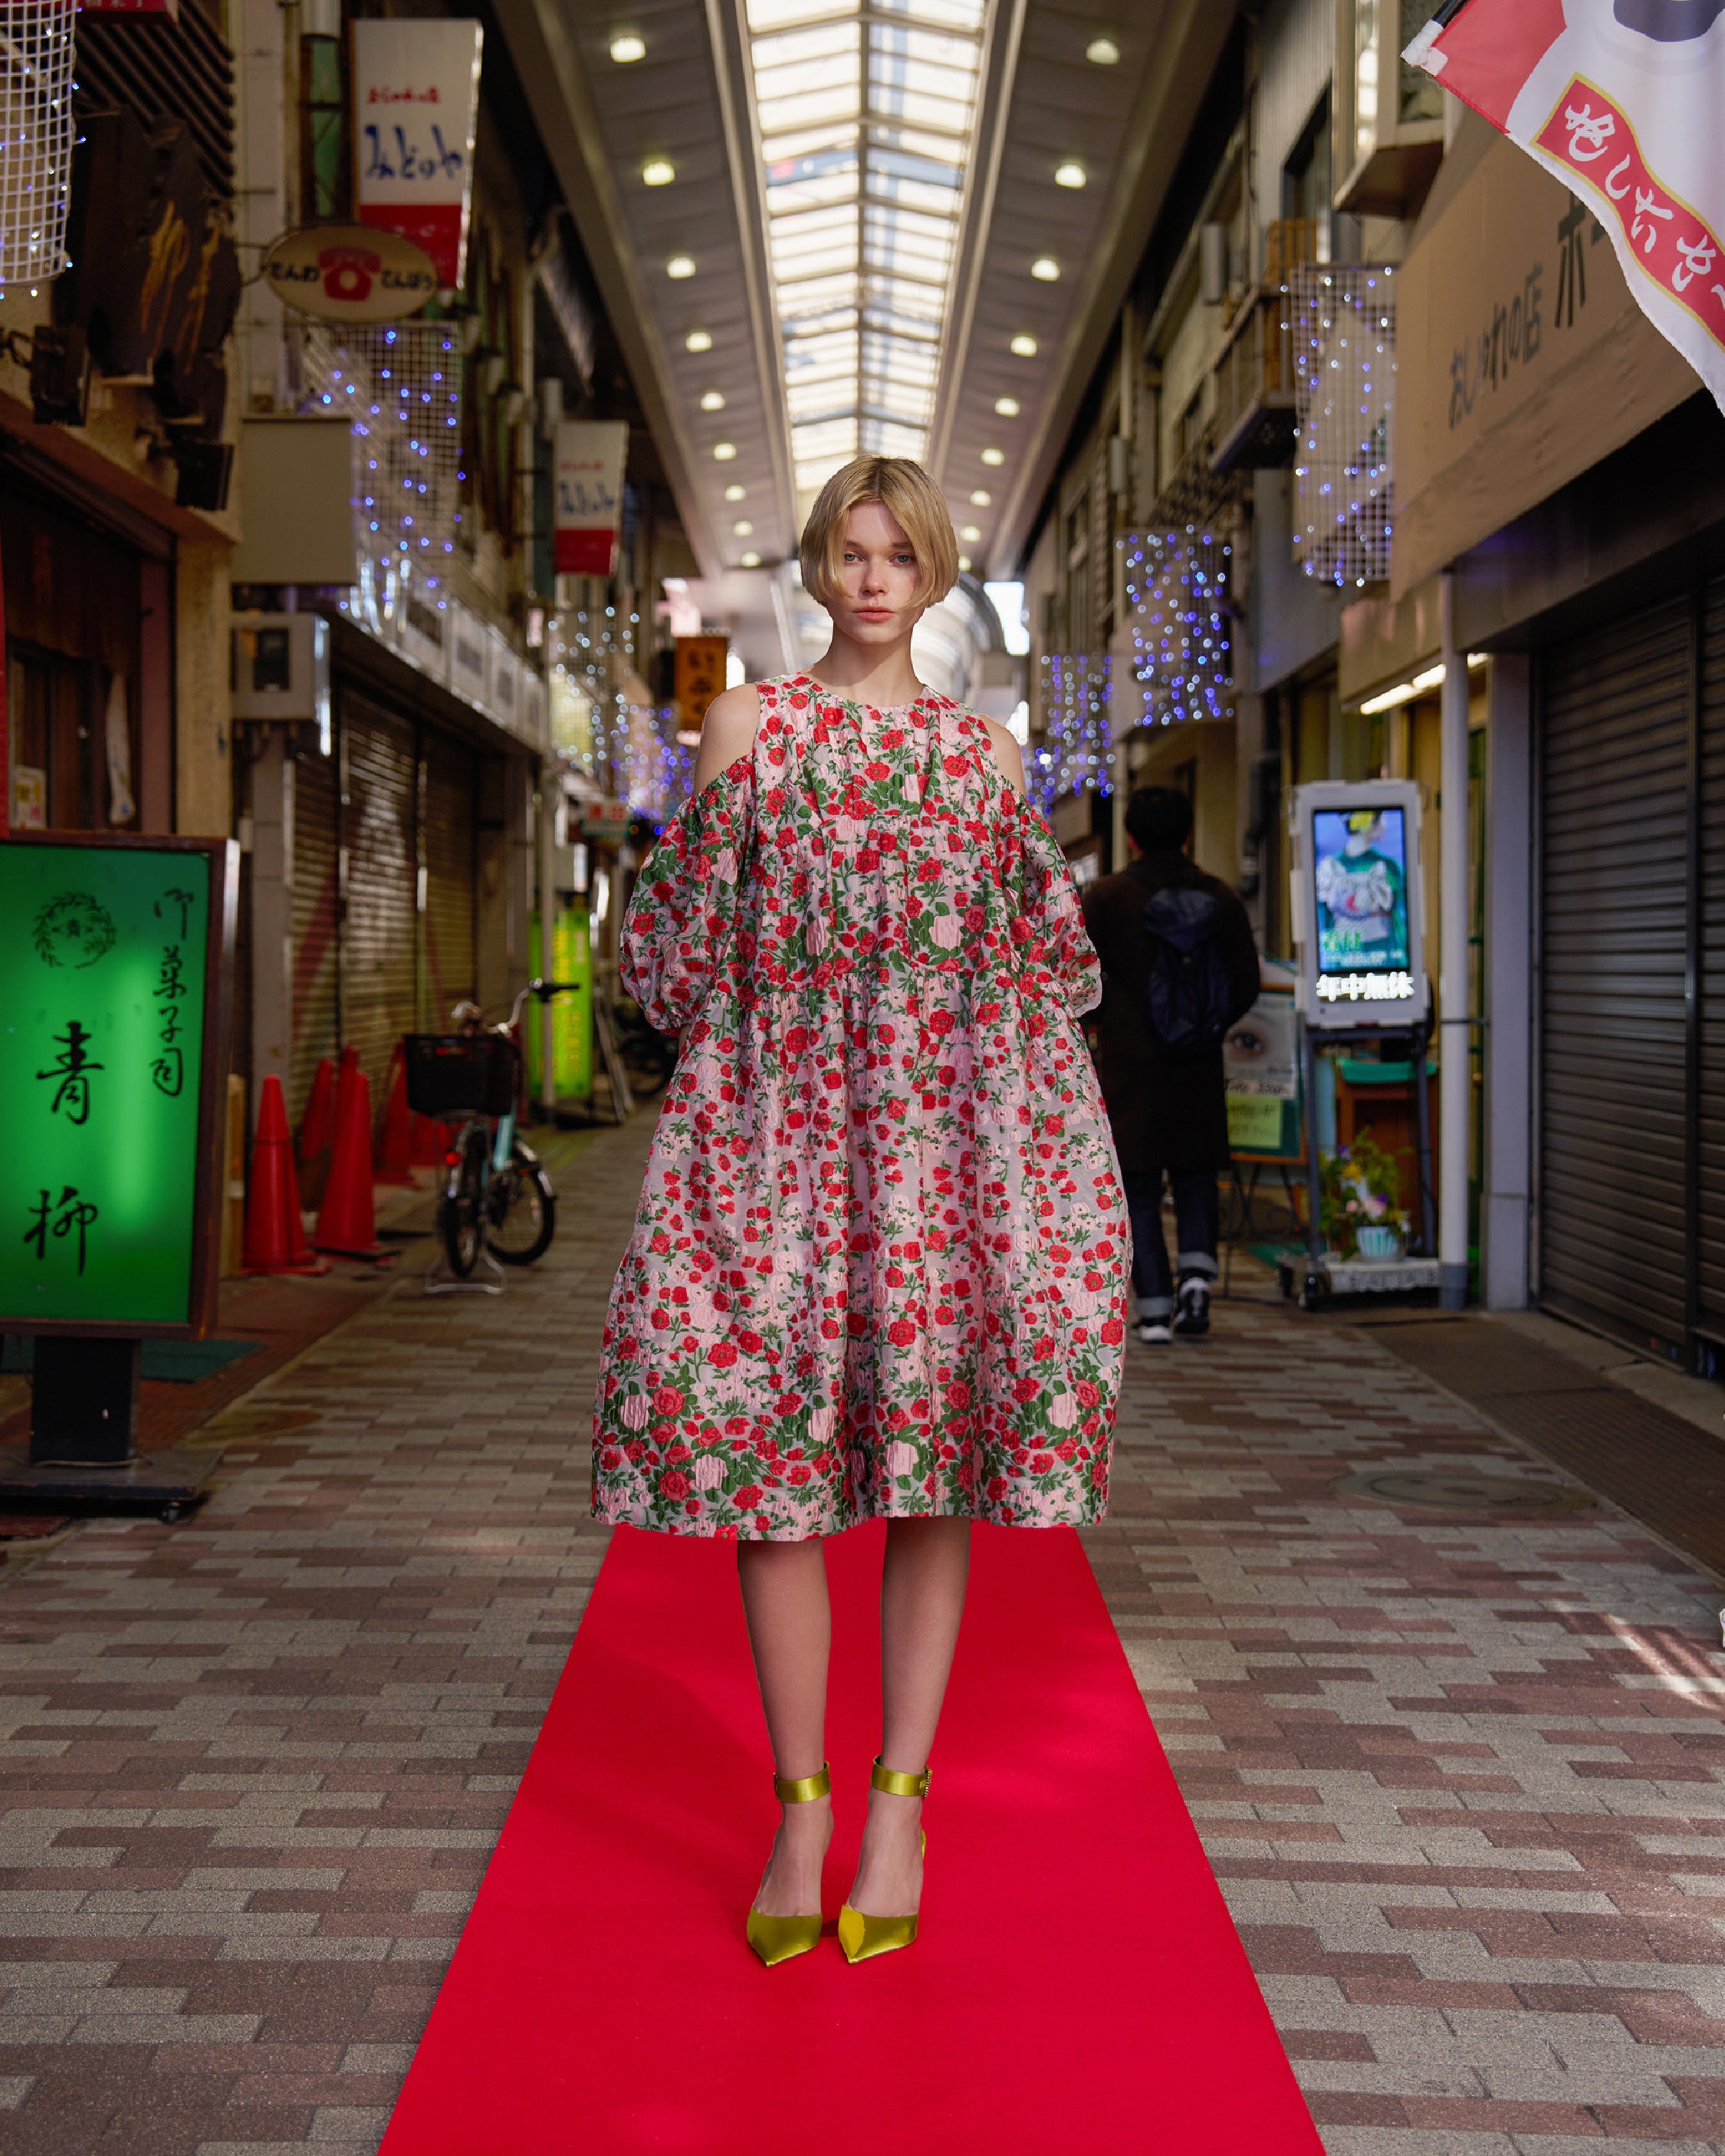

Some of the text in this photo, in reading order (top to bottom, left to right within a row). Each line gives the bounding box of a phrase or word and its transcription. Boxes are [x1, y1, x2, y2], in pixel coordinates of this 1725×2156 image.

[1448, 261, 1543, 431] おしゃれの店
[1316, 971, 1414, 1001] 年中無休
[23, 1020, 105, 1277] 青柳
